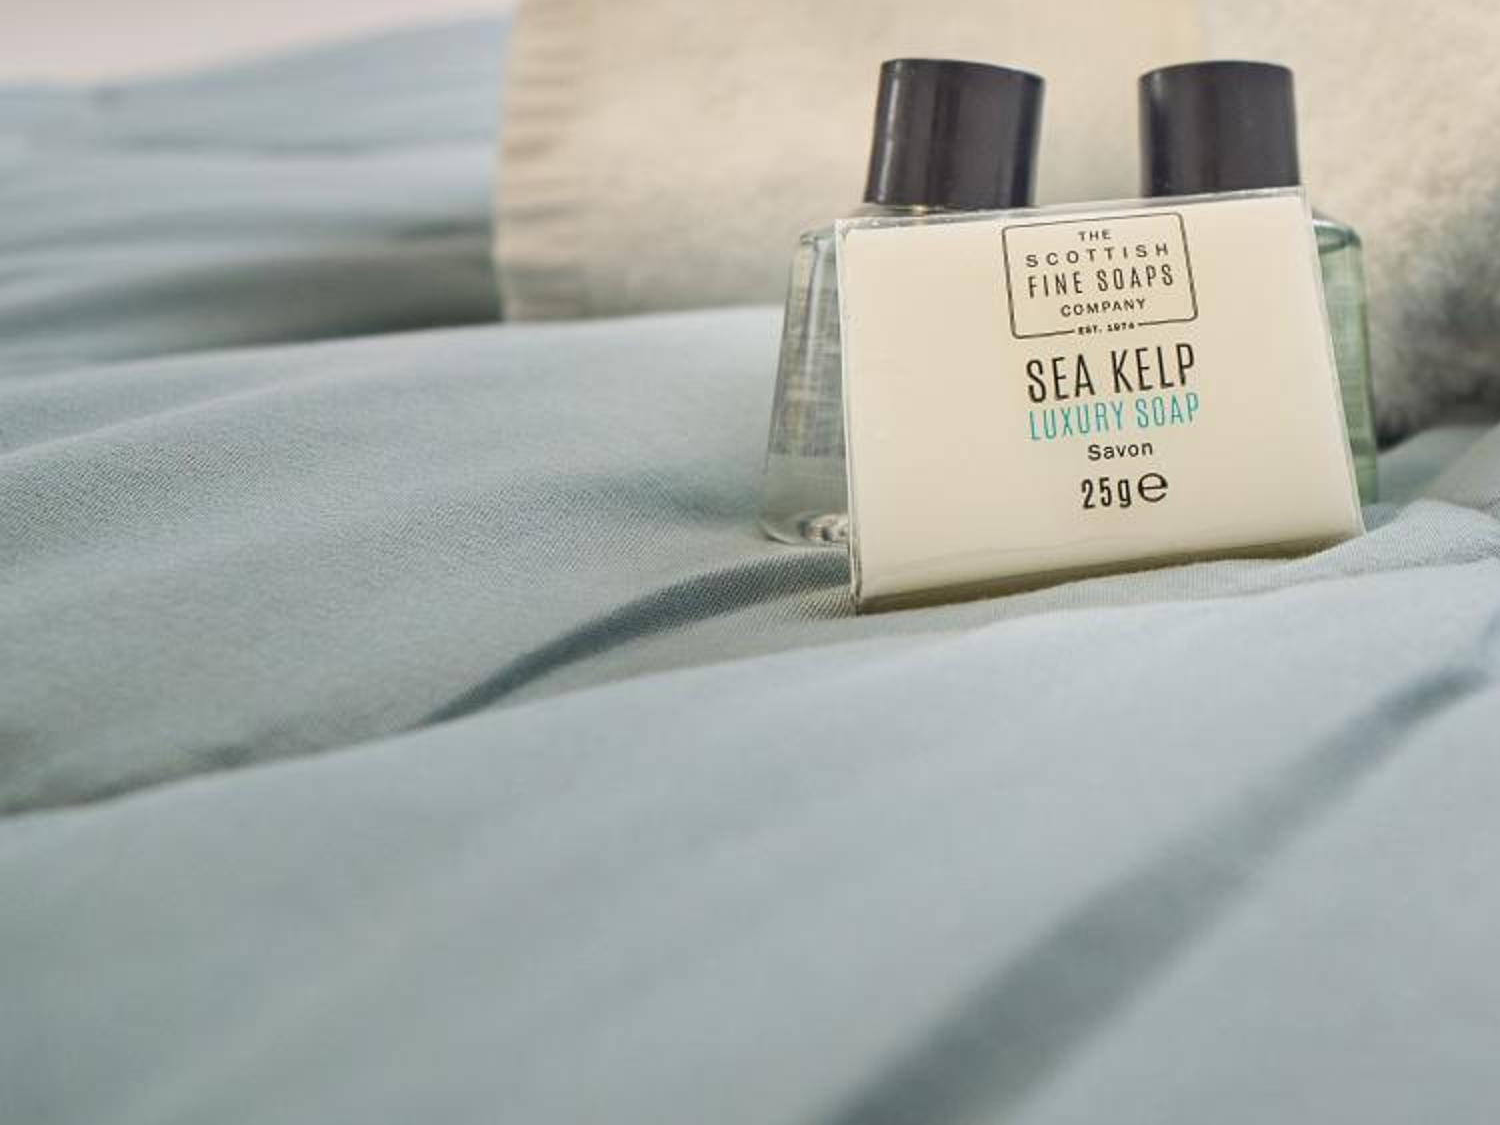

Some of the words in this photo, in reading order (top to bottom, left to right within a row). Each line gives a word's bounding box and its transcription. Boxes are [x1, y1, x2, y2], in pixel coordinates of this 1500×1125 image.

[1078, 229, 1111, 241] THE
[1025, 243, 1168, 268] SCOTTISH
[1028, 271, 1083, 298] FINE
[1097, 264, 1174, 292] SOAPS
[1060, 298, 1146, 317] COMPANY
[1078, 325, 1102, 335] EST.
[1026, 353, 1095, 403] SEA
[1111, 343, 1195, 394] KELP
[1029, 401, 1124, 441] LUXURY
[1135, 392, 1200, 429] SOAP
[1087, 442, 1153, 461] Savon
